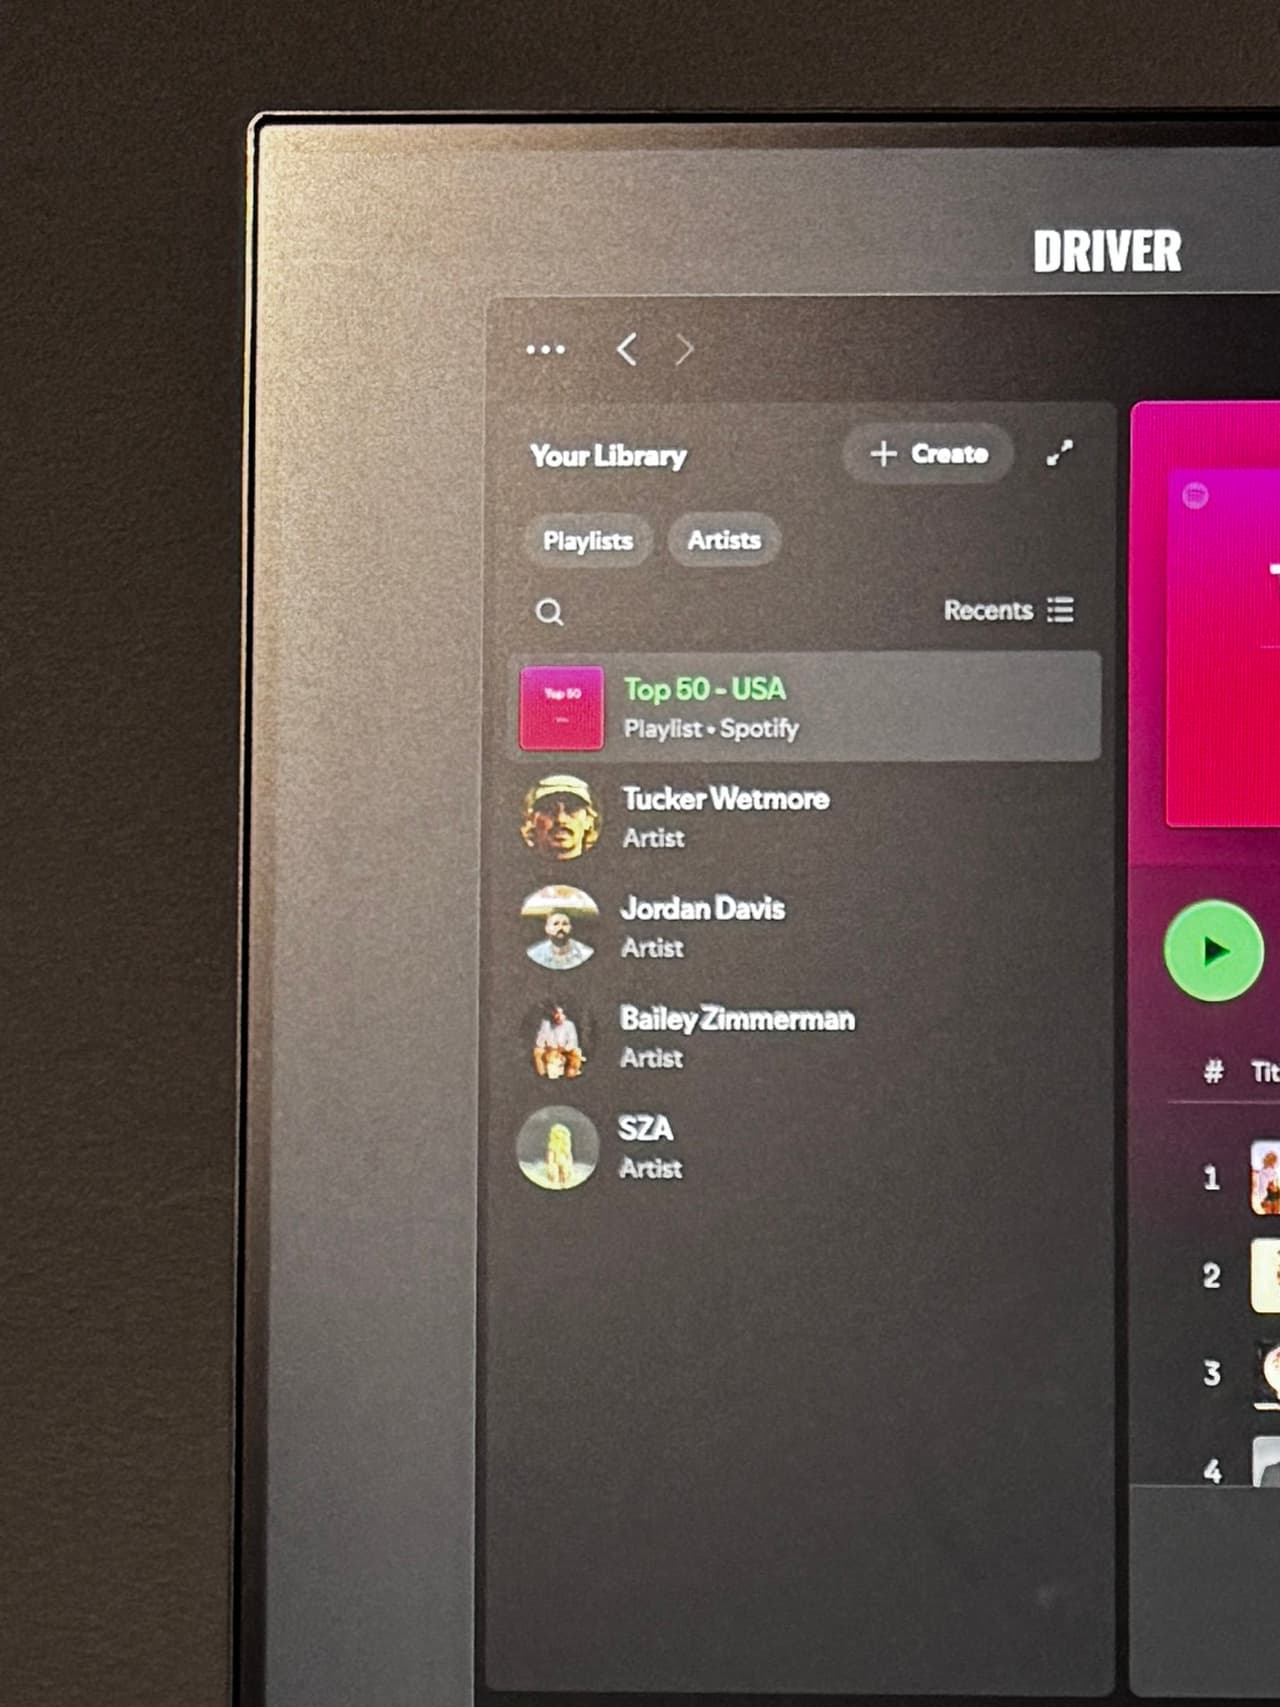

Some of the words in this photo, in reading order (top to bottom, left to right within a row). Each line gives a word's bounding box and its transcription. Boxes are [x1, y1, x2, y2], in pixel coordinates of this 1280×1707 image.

[1034, 228, 1182, 274] DRIVER
[530, 443, 590, 468] Your
[595, 442, 688, 472] Library
[911, 443, 989, 464] Create
[543, 529, 634, 554] Playlists
[687, 529, 762, 551] Artists
[944, 600, 1034, 622] Recents
[624, 677, 672, 705] Top
[676, 677, 711, 701] 50
[732, 676, 787, 701] USA
[624, 719, 702, 742] Playlist
[720, 718, 800, 743] Spotify
[624, 787, 707, 811] Tucker
[710, 787, 830, 811] Wetmore
[623, 828, 685, 849] Artist
[620, 897, 711, 921] Jordan
[715, 896, 786, 921] Davis
[620, 939, 684, 960] Artist
[620, 1006, 698, 1036] Bailey
[701, 1007, 856, 1033] Zimmerman
[620, 1049, 684, 1070] Artist
[618, 1115, 674, 1142] SZA
[619, 1159, 683, 1181] Artist
[1203, 1167, 1221, 1192] 1
[1203, 1264, 1221, 1289] 2
[1203, 1361, 1221, 1386] 3
